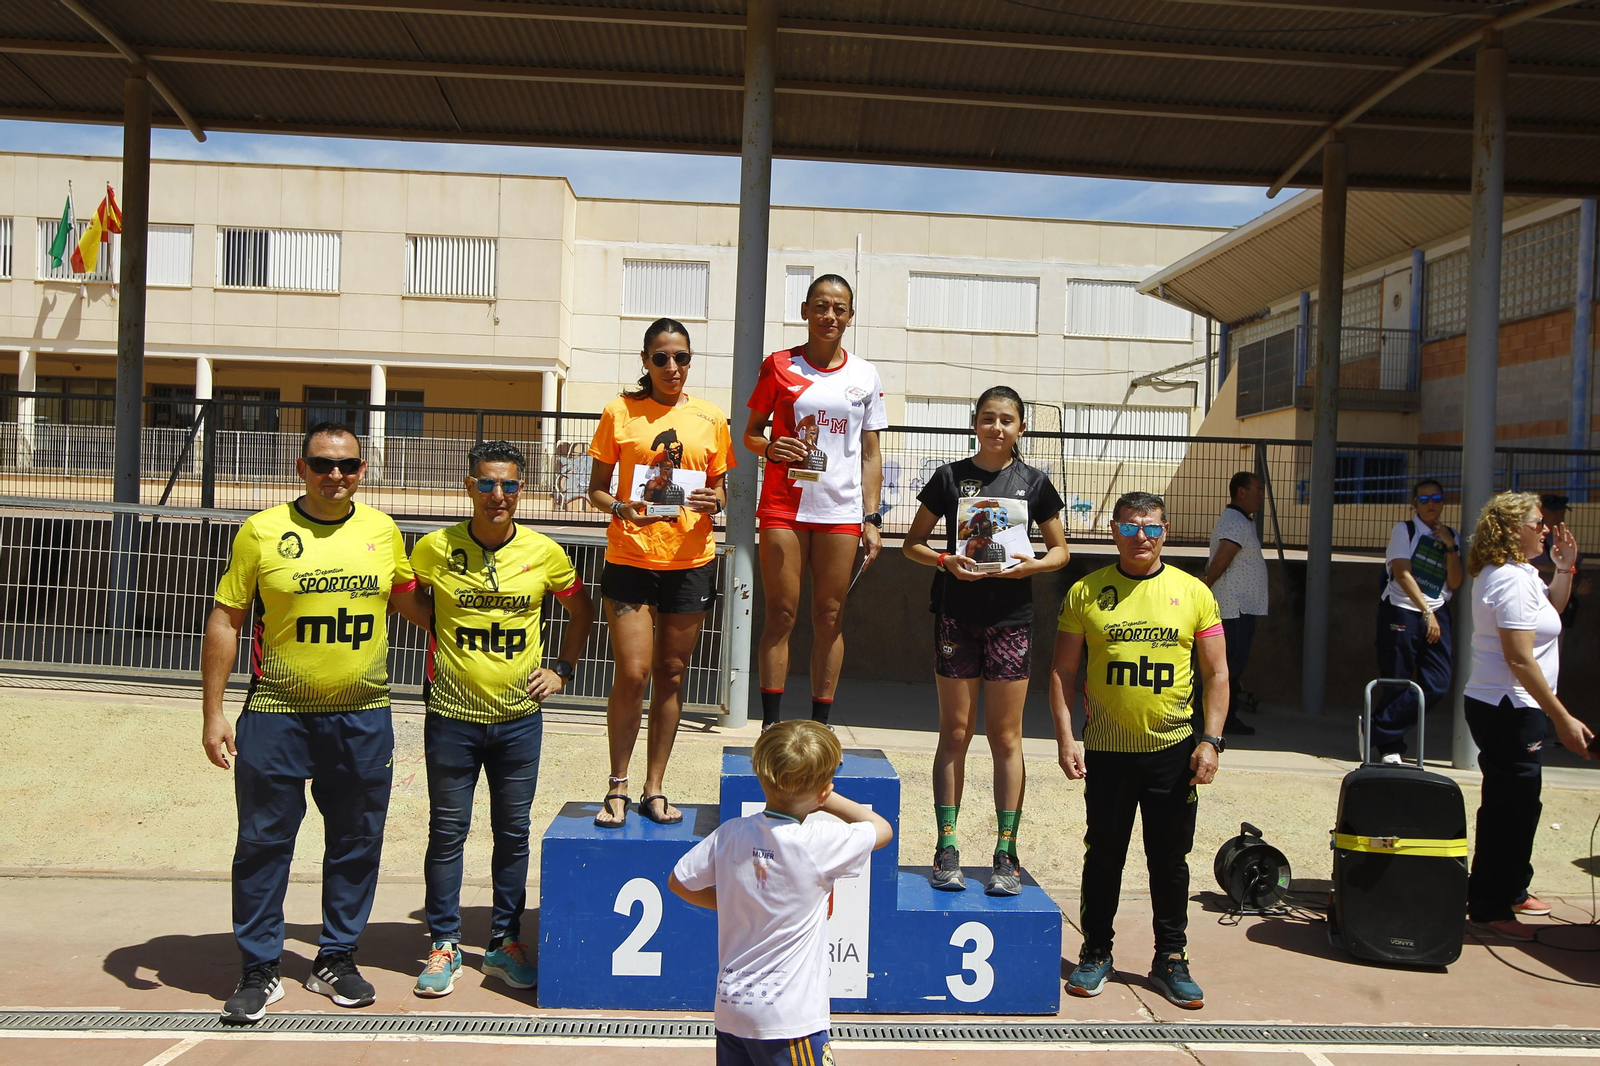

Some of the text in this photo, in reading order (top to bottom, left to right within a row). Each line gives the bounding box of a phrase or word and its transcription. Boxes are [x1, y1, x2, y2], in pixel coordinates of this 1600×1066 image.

[809, 449, 825, 458] XIII
[294, 575, 380, 594] SPORTGYM
[455, 594, 531, 609] SPORTGYM
[296, 607, 375, 650] mtp
[455, 622, 527, 660] mtp
[1106, 627, 1179, 642] SPORTGYM
[1106, 655, 1175, 695] mtp
[611, 877, 663, 977] 2
[1389, 939, 1415, 947] VONYX
[945, 921, 995, 1003] 3
